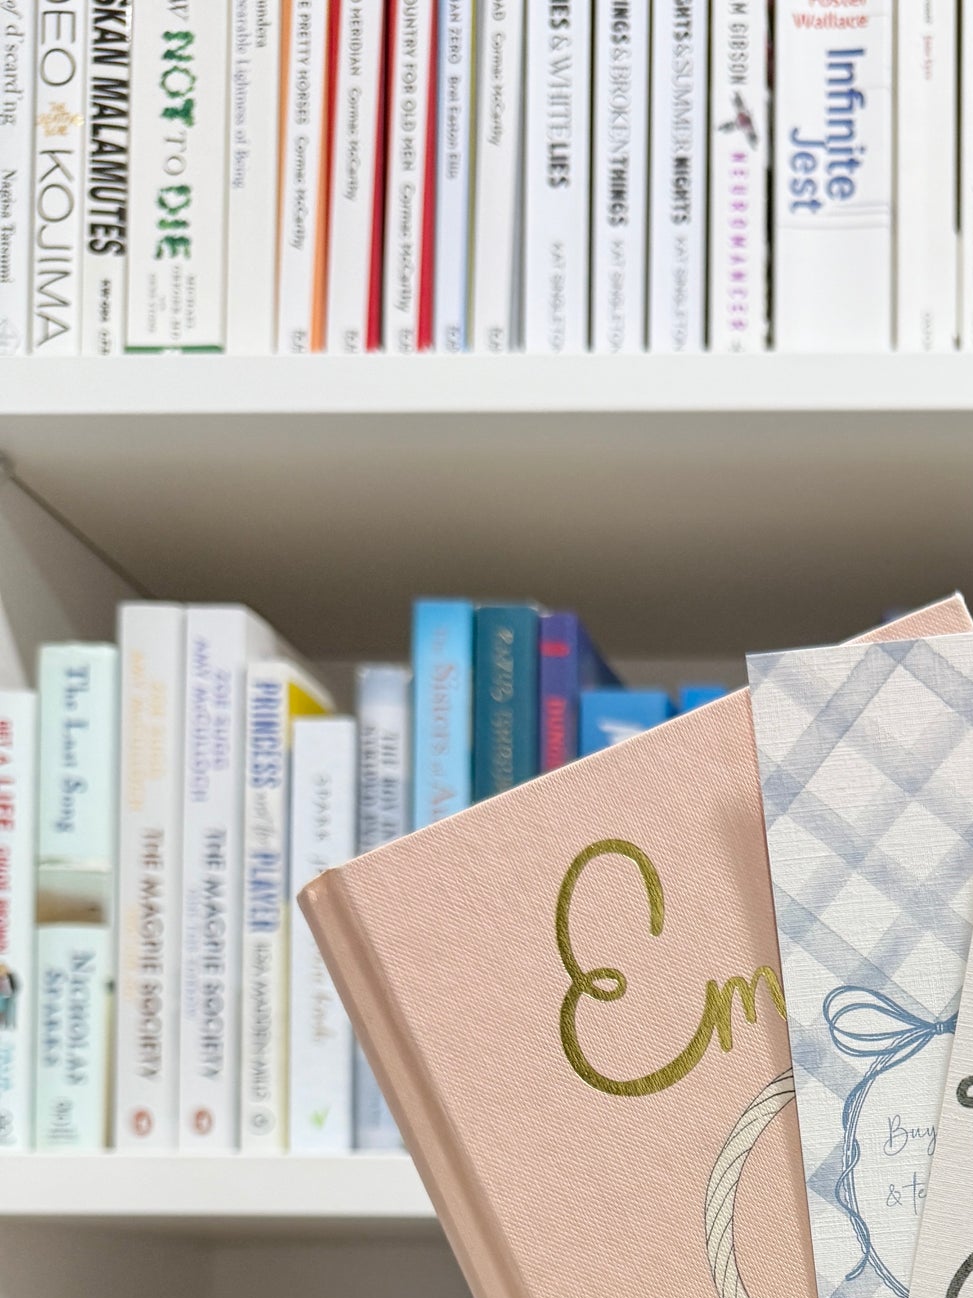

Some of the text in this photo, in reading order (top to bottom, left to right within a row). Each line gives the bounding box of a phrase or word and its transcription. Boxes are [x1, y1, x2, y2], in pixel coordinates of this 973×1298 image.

[610, 48, 632, 62] &
[793, 12, 869, 30] Wallace
[161, 31, 197, 127] NOT
[232, 60, 249, 126] Lightness
[342, 7, 361, 201] MERIDIAN Cormac McCarthy
[548, 35, 572, 189] & WHITE LIES
[608, 65, 632, 156] BROKEN
[826, 48, 866, 200] Infinite
[88, 78, 128, 255] MALAMUTES
[164, 131, 188, 177] TO
[230, 150, 247, 189] Being
[288, 14, 310, 252] PRETTY HORSES Cormac McCarthy
[670, 44, 694, 226] & SUMMER NIGHTS
[728, 23, 747, 332] GIBSON NEUROMANCER
[789, 126, 827, 215] Jest
[155, 185, 193, 261] DIE
[394, 64, 416, 313] FOR OLD MEN Cormac McCarthy
[608, 156, 630, 228] THINGS
[37, 150, 75, 348] KOJIMA
[64, 664, 90, 709] The
[430, 663, 458, 755] Sisters
[54, 776, 90, 833] Song
[248, 682, 280, 934] PRINCESS PLAYER
[137, 829, 163, 1081] THE MAGPIE SOCIETY
[199, 829, 226, 1081] THE MAGPIE SOCIETY
[65, 949, 96, 1086] NICHOLAS
[884, 1113, 937, 1156] Buy
[886, 1184, 903, 1207] &
